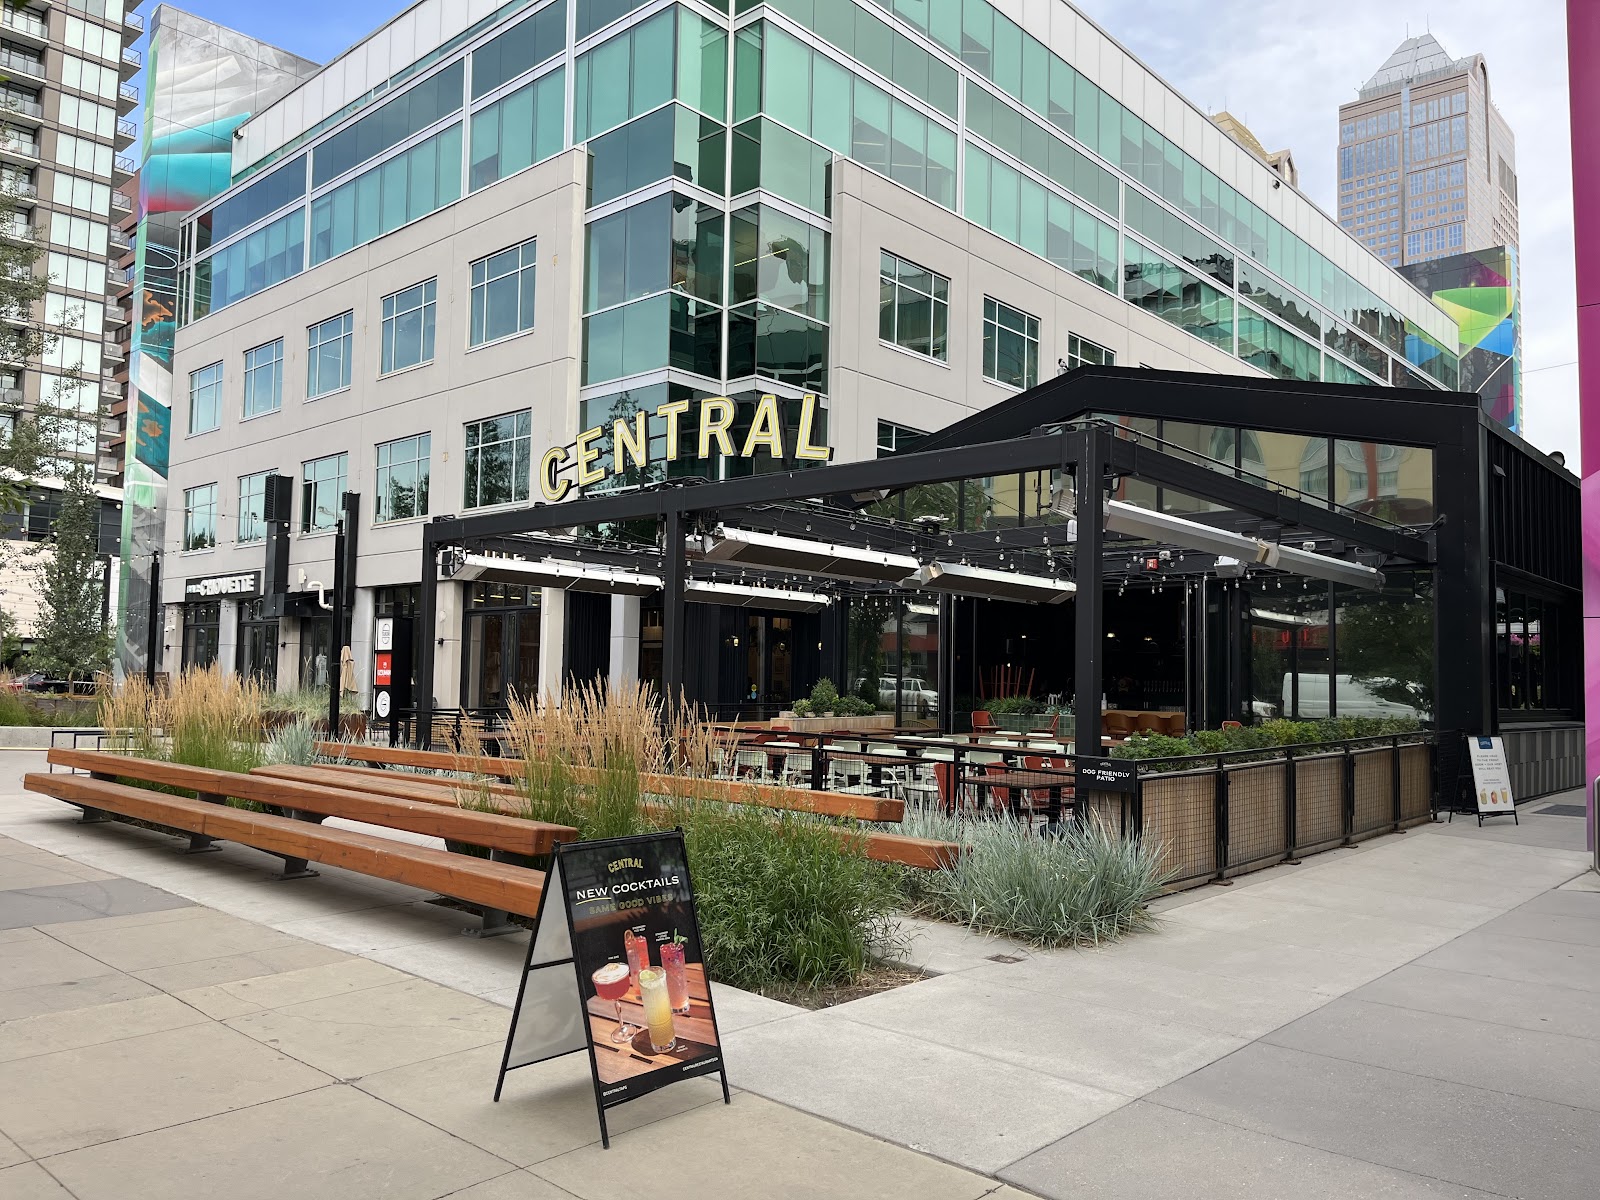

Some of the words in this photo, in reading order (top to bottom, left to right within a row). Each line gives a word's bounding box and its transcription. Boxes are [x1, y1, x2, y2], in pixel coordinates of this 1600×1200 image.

[540, 393, 834, 502] CENTRAL
[200, 574, 255, 596] CHOUETTE
[1097, 769, 1130, 777] FRIENDLY
[607, 857, 644, 873] CENTRAL
[576, 886, 608, 900] NEW
[612, 875, 680, 894] COCKTAILS
[589, 903, 617, 915] SAME
[619, 898, 645, 910] GOOD
[646, 893, 674, 905] VIBES
